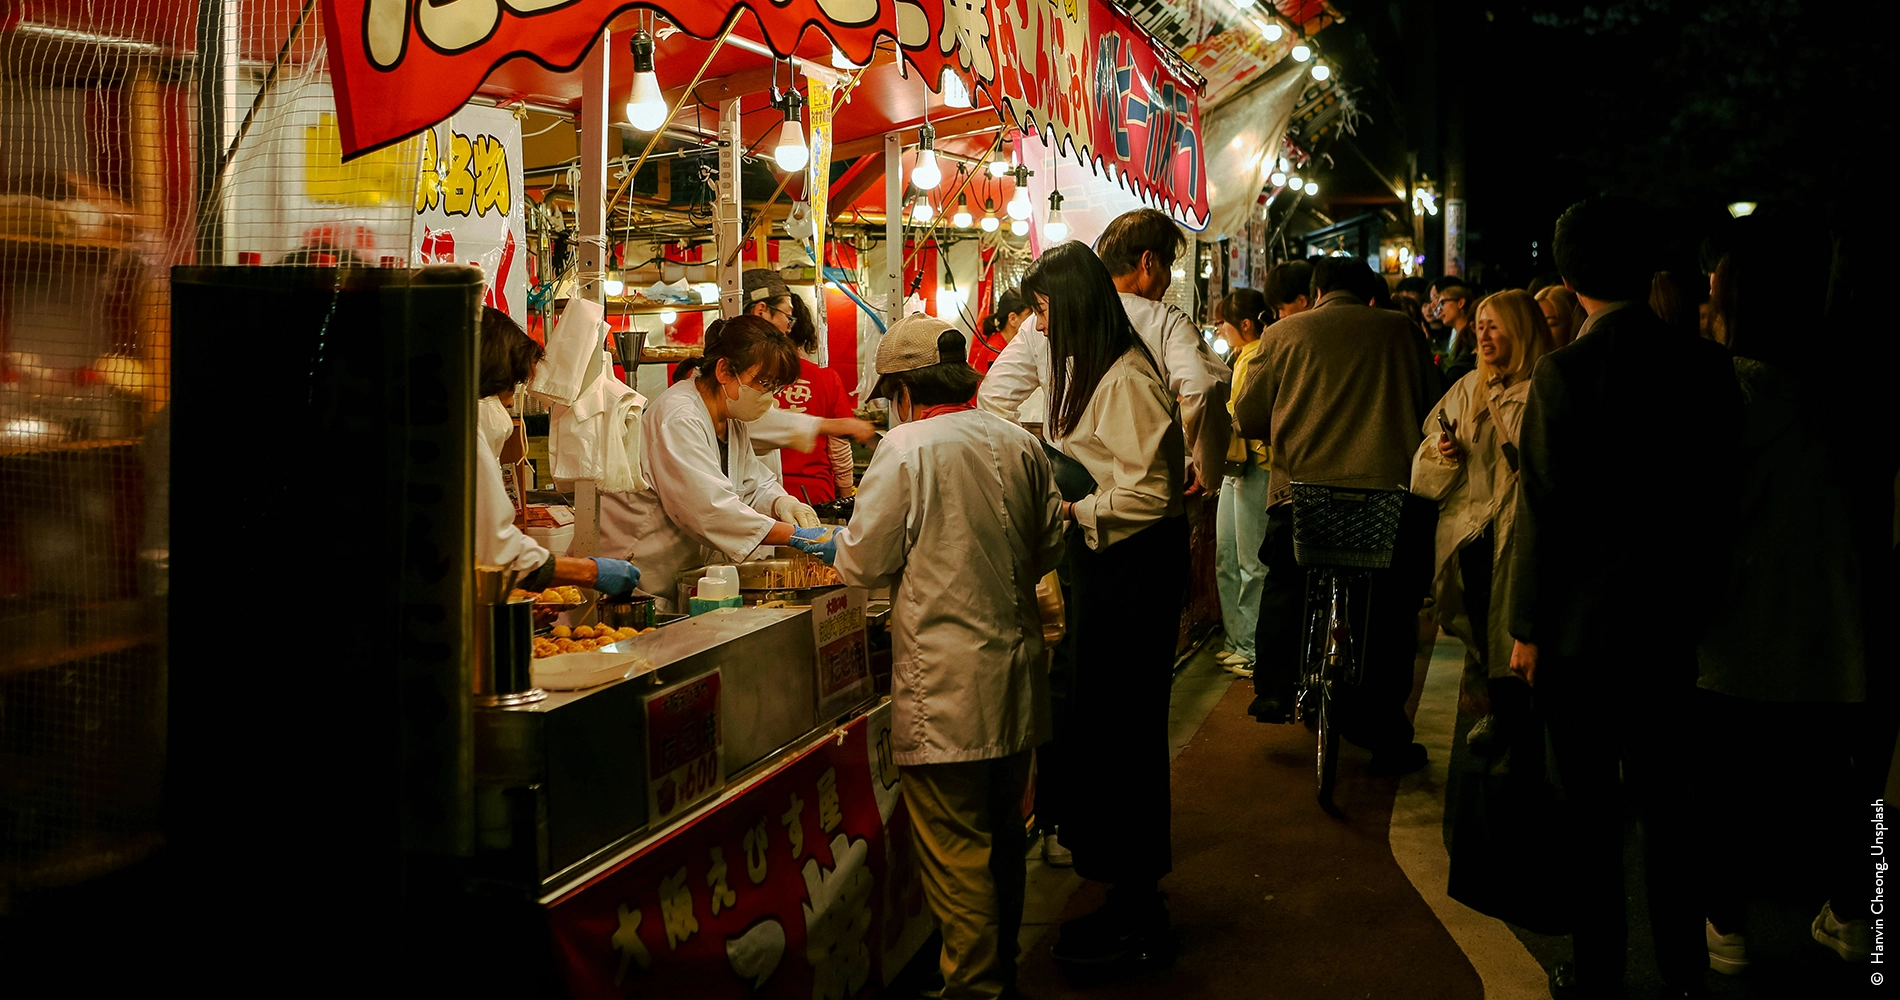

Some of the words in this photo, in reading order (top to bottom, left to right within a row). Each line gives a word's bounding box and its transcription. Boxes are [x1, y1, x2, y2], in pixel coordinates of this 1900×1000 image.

[611, 765, 843, 988] 大阪えびす屋
